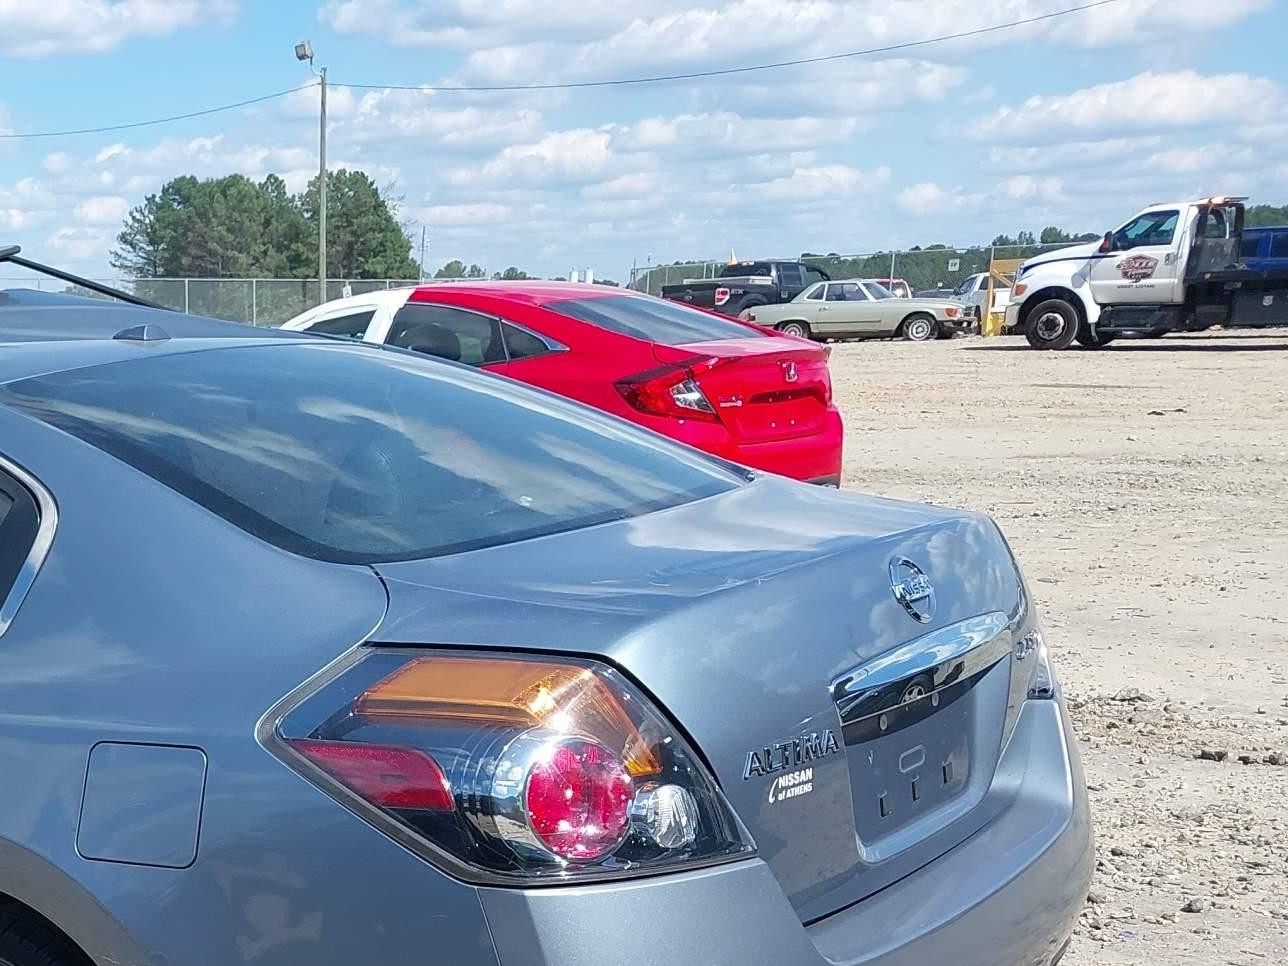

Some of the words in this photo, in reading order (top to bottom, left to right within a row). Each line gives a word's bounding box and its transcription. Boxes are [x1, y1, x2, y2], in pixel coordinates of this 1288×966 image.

[743, 730, 839, 780] ALTIMA
[778, 767, 813, 788] NISSAN
[777, 790, 786, 801] of
[786, 782, 813, 798] ATHENS
